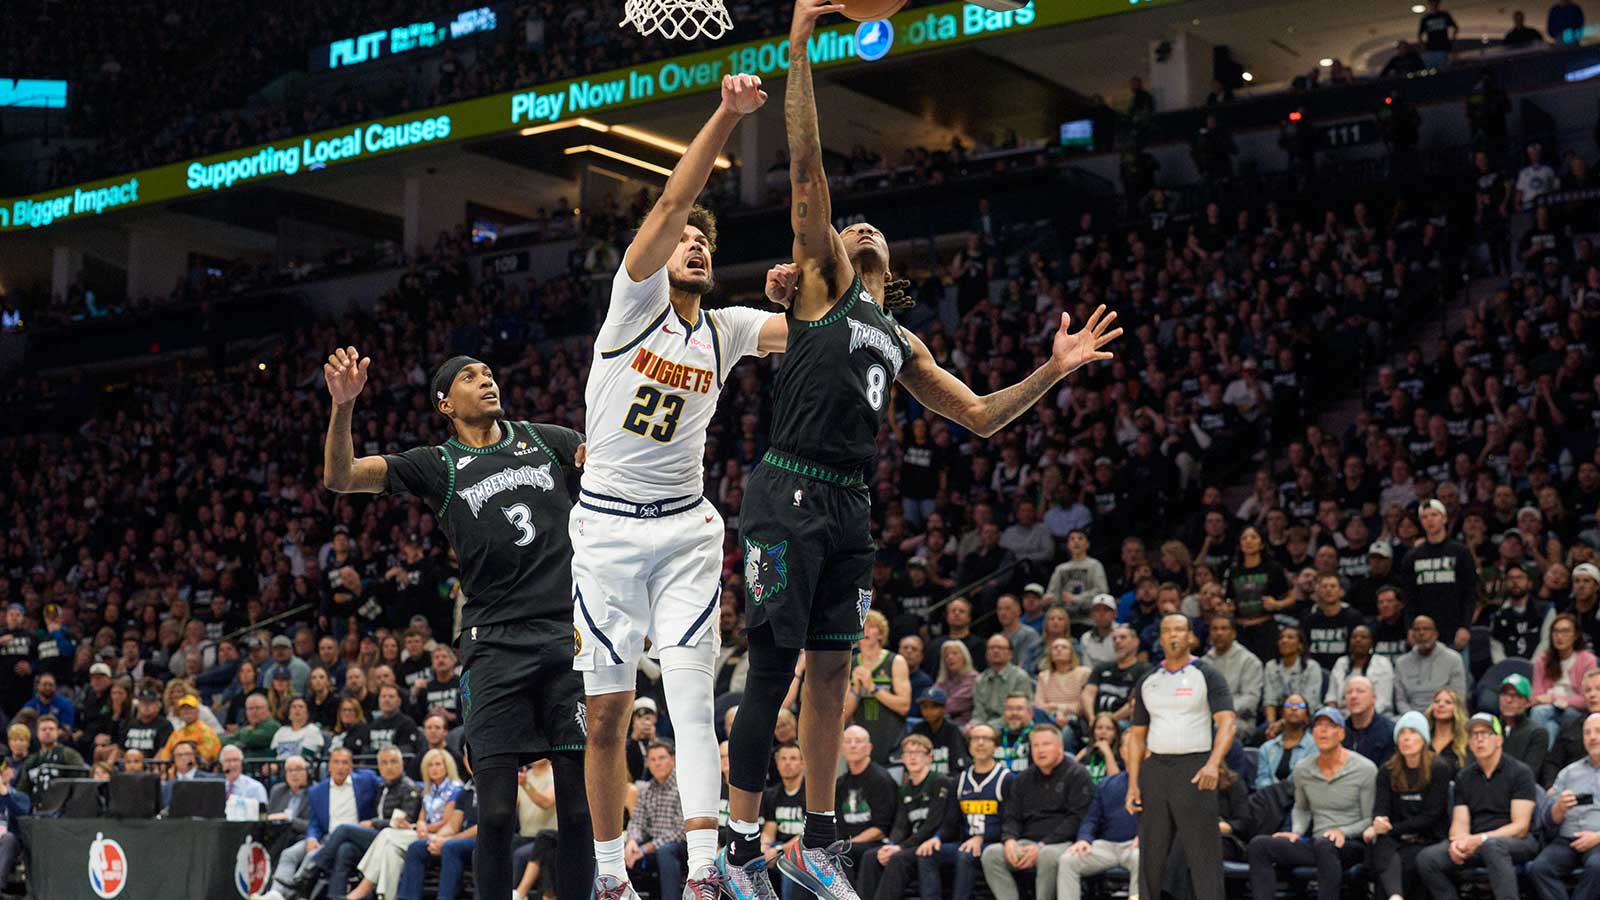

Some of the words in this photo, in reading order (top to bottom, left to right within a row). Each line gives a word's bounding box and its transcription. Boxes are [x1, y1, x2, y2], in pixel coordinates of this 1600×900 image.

[511, 92, 565, 123] Play
[568, 79, 626, 112] Now
[629, 70, 654, 100] In
[659, 60, 723, 93] Over
[728, 39, 790, 75] 1800
[806, 13, 957, 64] Minota
[963, 1, 1036, 36] Bars
[187, 146, 300, 190] Supporting
[302, 127, 362, 166] Local
[365, 115, 450, 152] Causes
[1328, 124, 1361, 147] 111
[13, 196, 73, 228] Bigger
[73, 178, 139, 214] Impact
[630, 347, 714, 395] NUGGETS
[846, 316, 904, 384] TIMBERWOL
[622, 384, 687, 444] 23
[866, 363, 887, 412] 8
[456, 461, 555, 519] TIMBERWOLVES
[501, 502, 536, 547] 3
